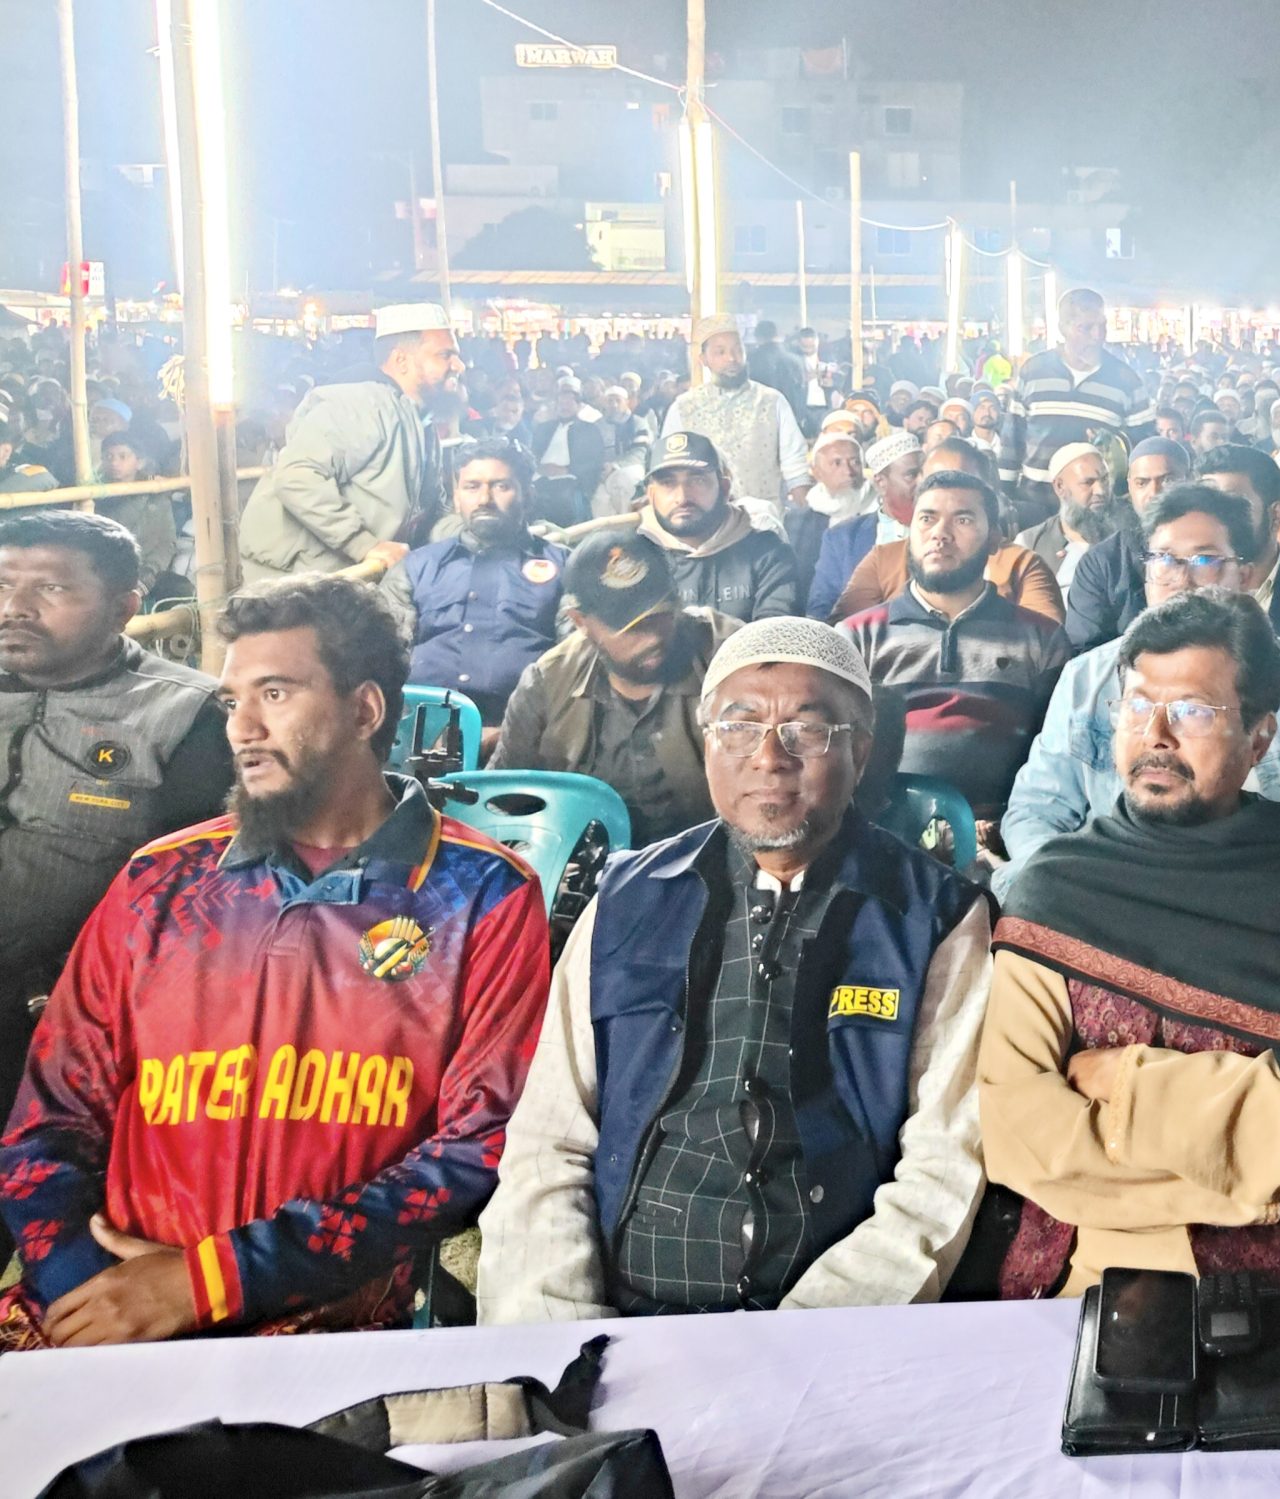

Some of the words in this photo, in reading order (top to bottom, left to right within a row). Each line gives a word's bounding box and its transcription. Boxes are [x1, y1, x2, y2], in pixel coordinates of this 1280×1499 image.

[525, 48, 614, 65] MARWAH
[98, 749, 114, 763] K
[138, 1043, 257, 1125] PATER
[258, 1043, 414, 1127] ADHAR
